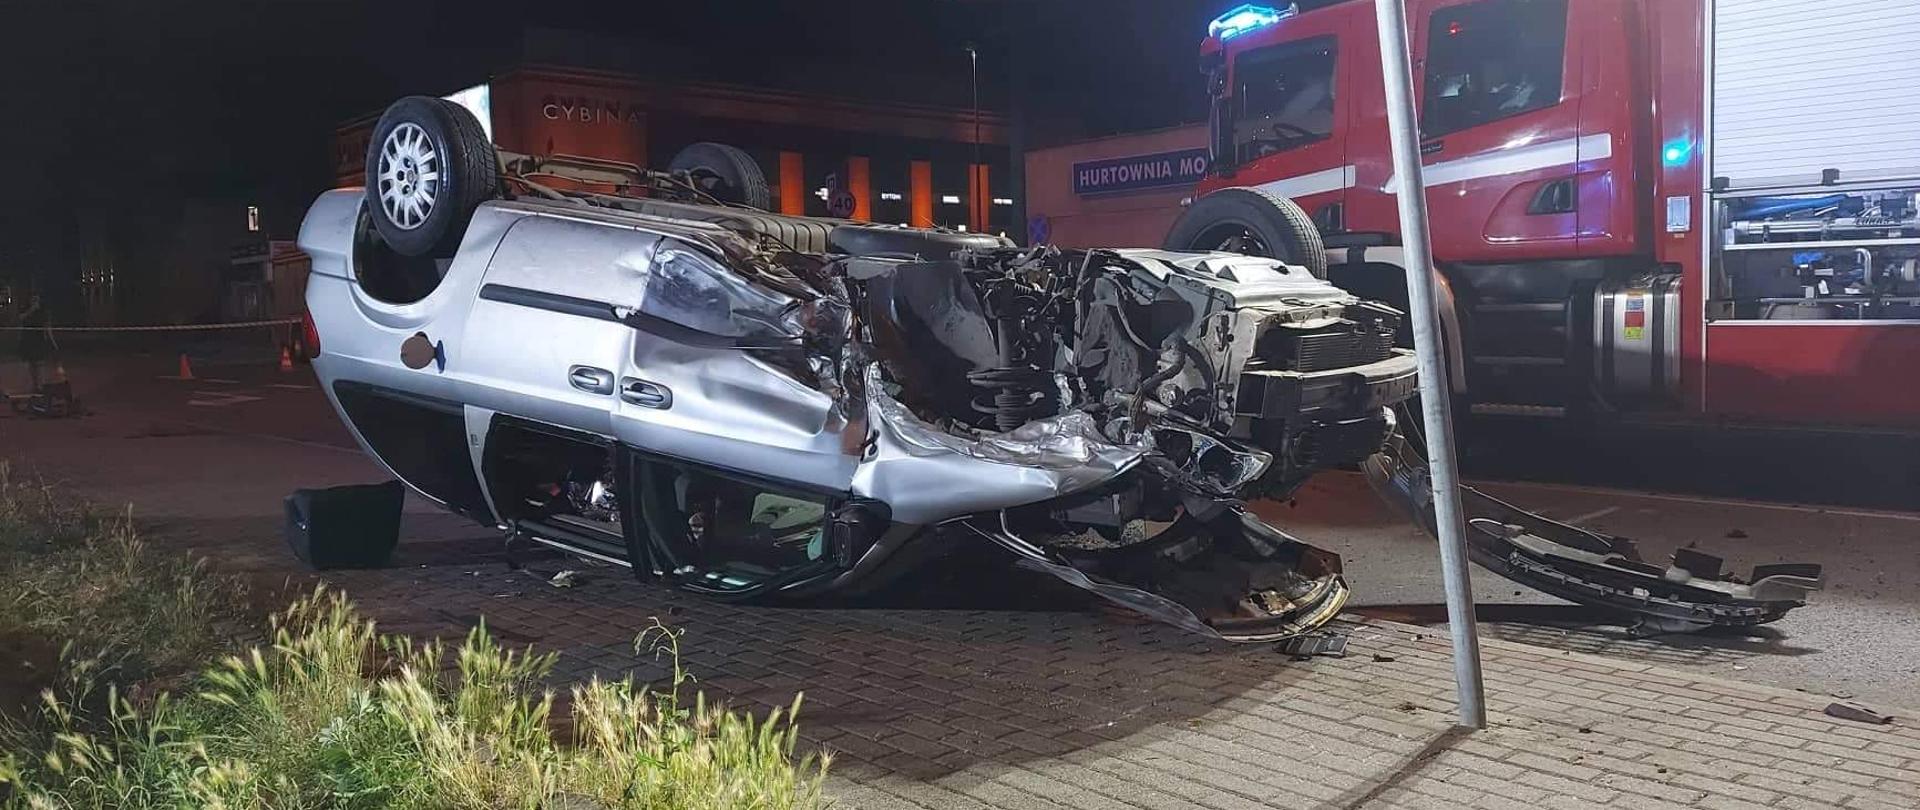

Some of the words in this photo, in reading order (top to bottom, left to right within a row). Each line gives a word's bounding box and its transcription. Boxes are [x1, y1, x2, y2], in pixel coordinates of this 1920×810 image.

[543, 104, 640, 124] CYBINA
[1079, 161, 1172, 186] HURTOWNIA
[834, 197, 852, 210] 40
